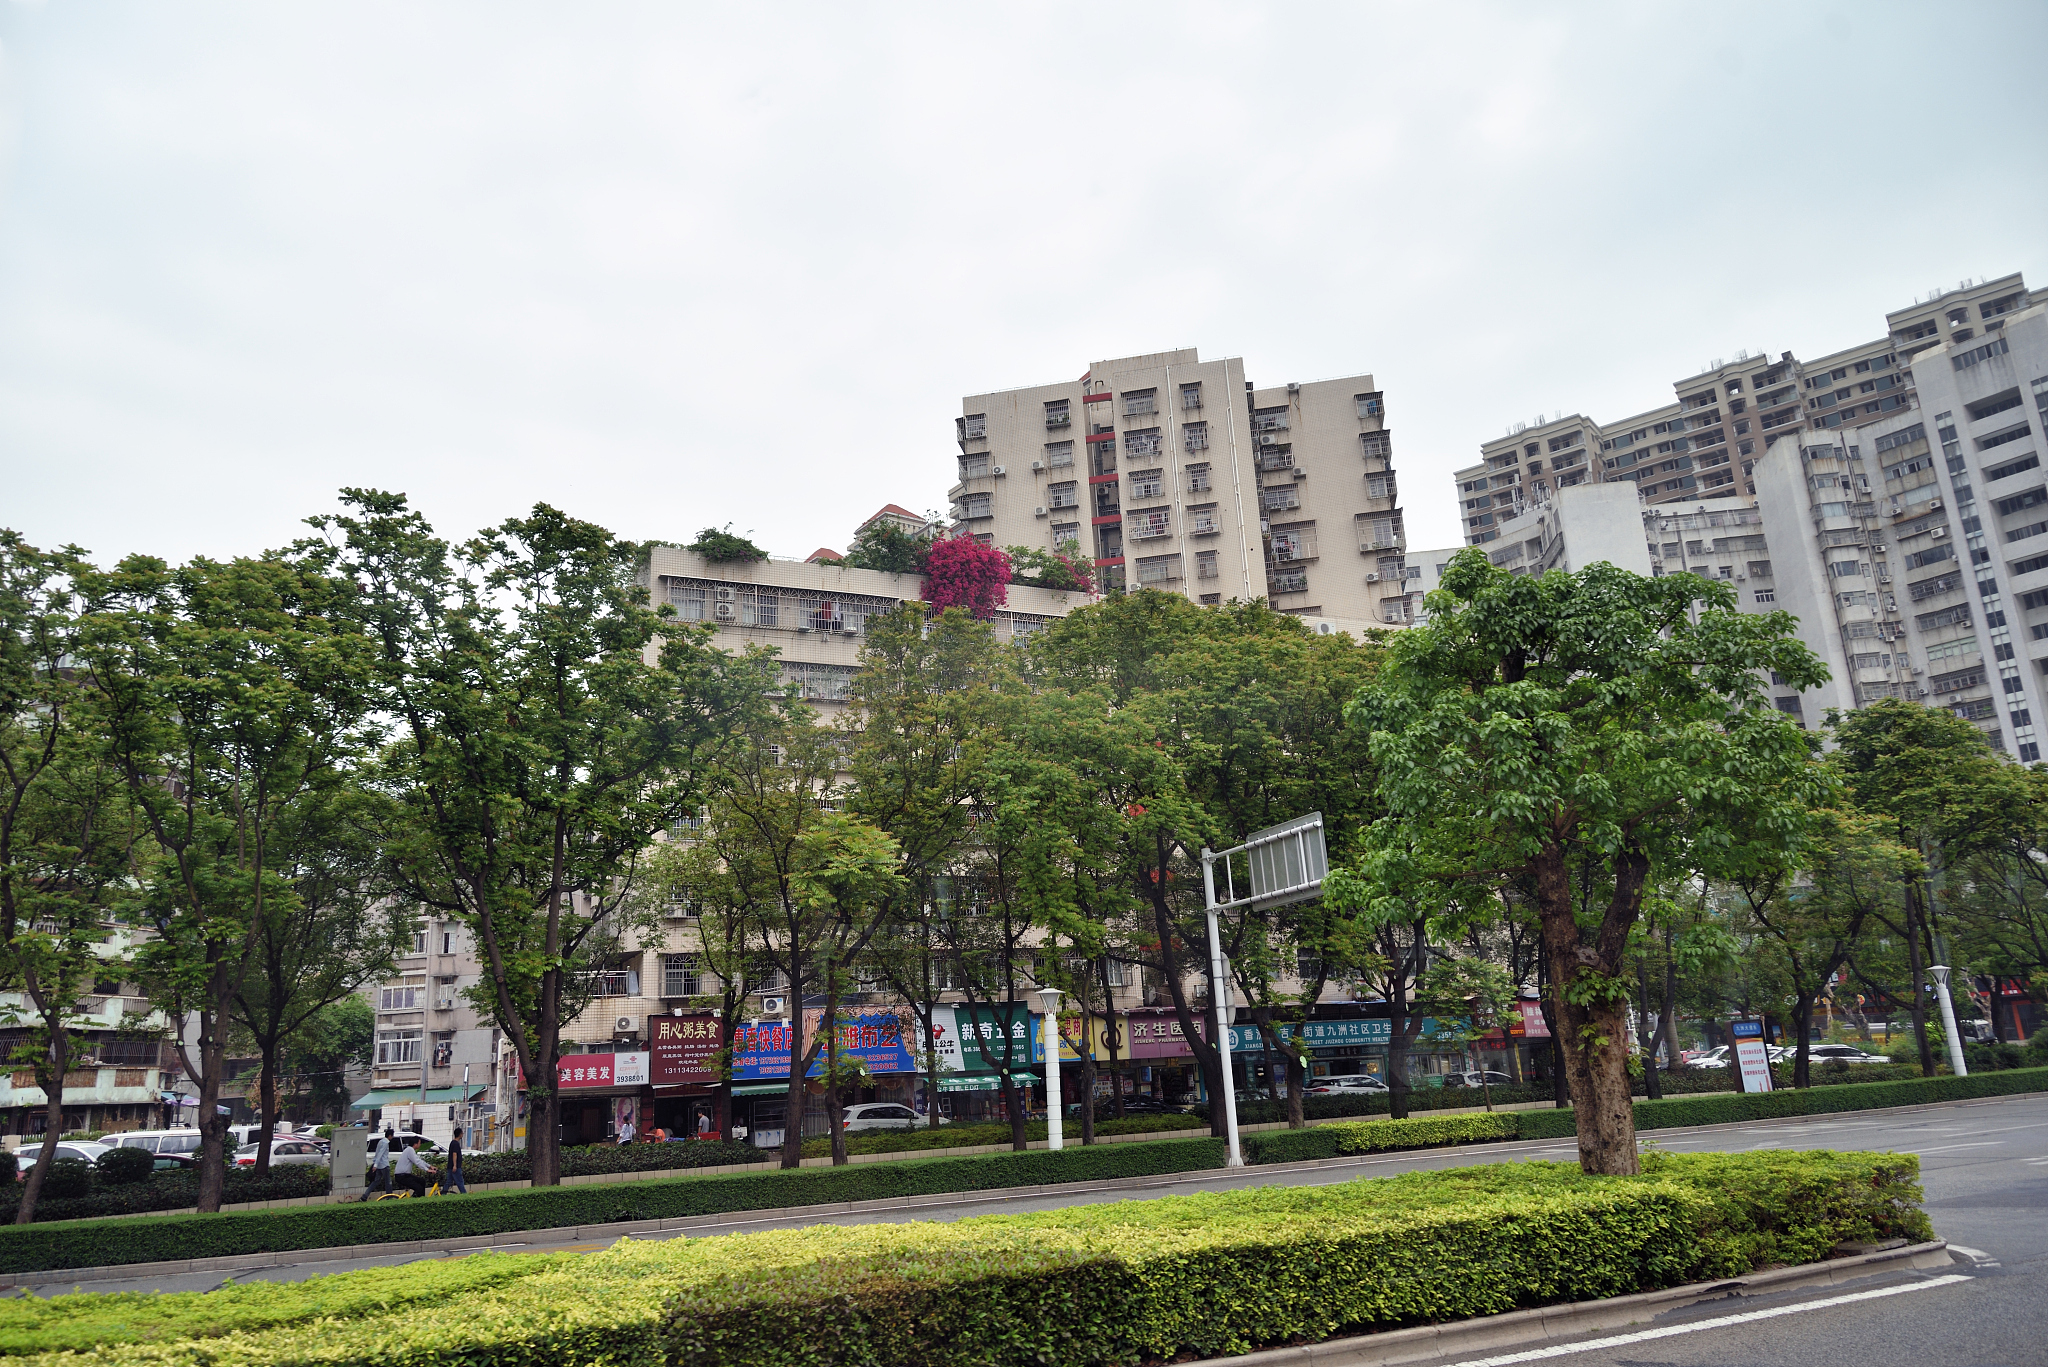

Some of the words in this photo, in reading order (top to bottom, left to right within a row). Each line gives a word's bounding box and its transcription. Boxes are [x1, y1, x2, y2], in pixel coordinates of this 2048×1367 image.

[658, 1020, 719, 1040] 用心粥美食
[822, 1025, 898, 1050] 雅布艺
[561, 1066, 610, 1082] 美容美发
